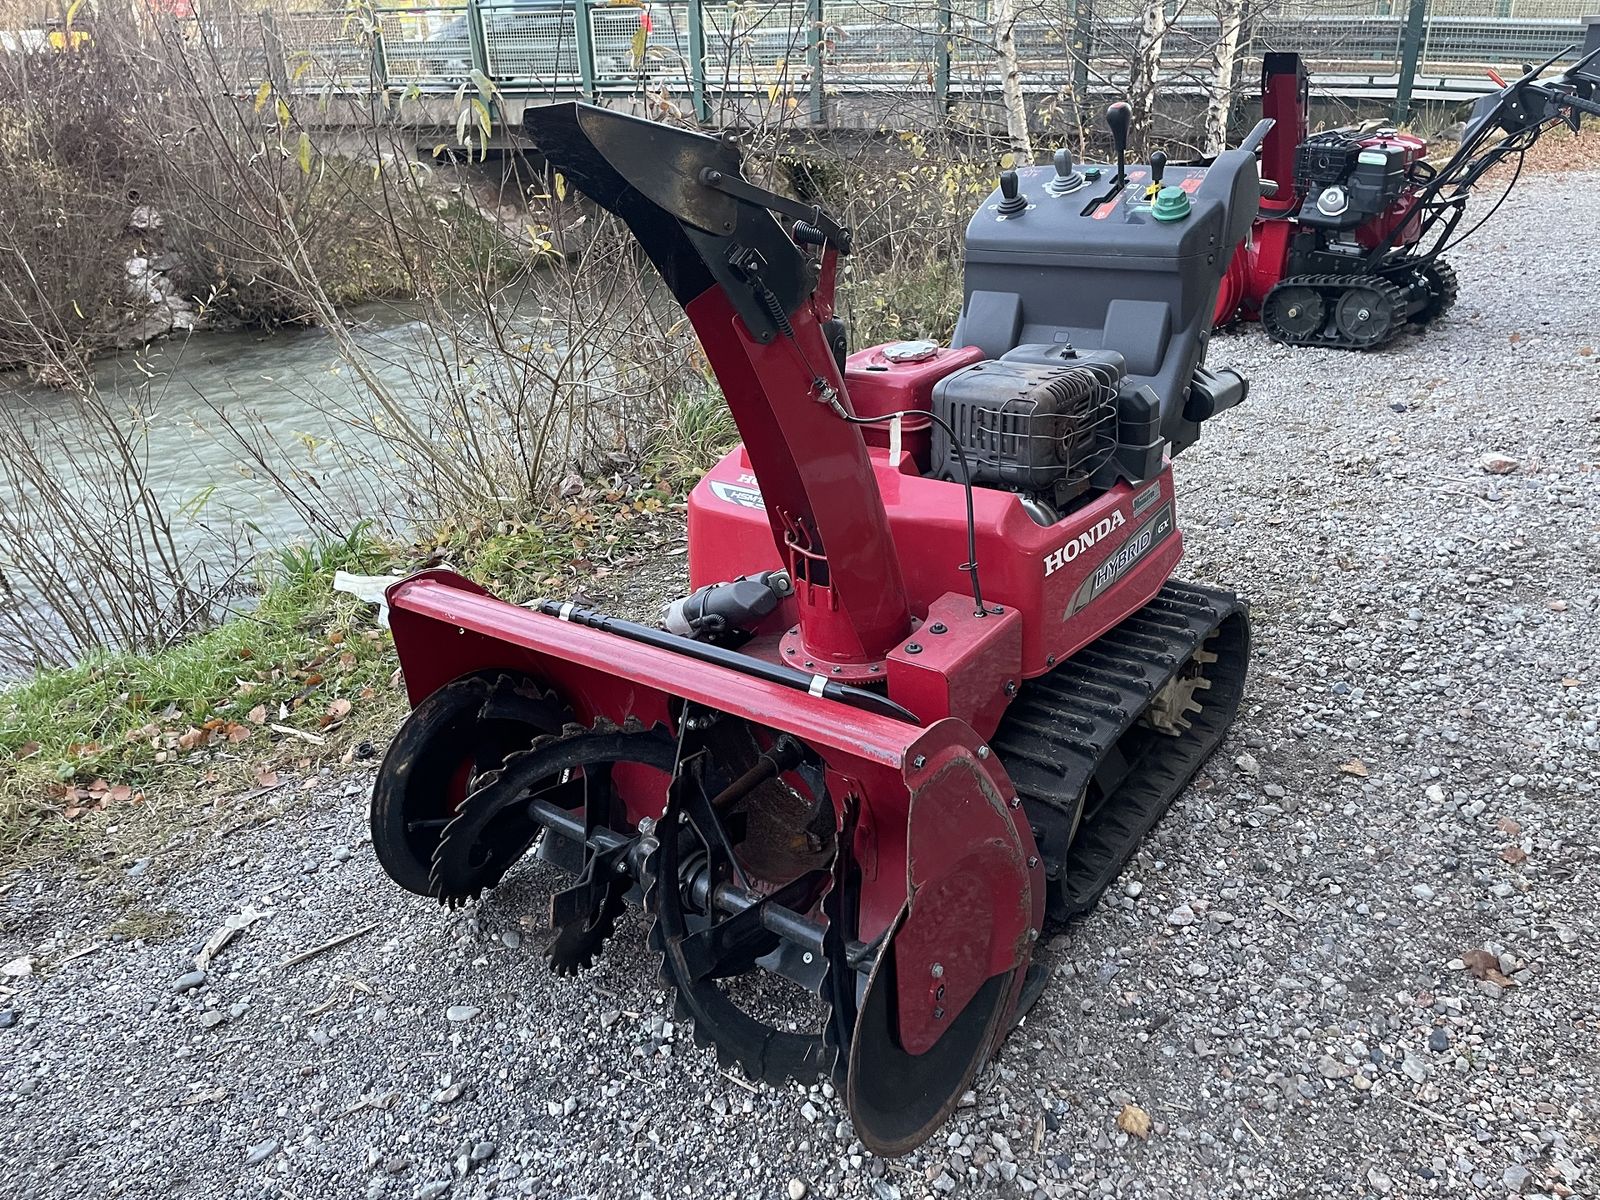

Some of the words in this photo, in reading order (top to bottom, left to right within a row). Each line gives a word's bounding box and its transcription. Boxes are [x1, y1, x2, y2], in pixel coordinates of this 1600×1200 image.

[1043, 509, 1126, 577] HONDA
[1095, 530, 1151, 589] HYBRID
[1157, 518, 1169, 534] GX
